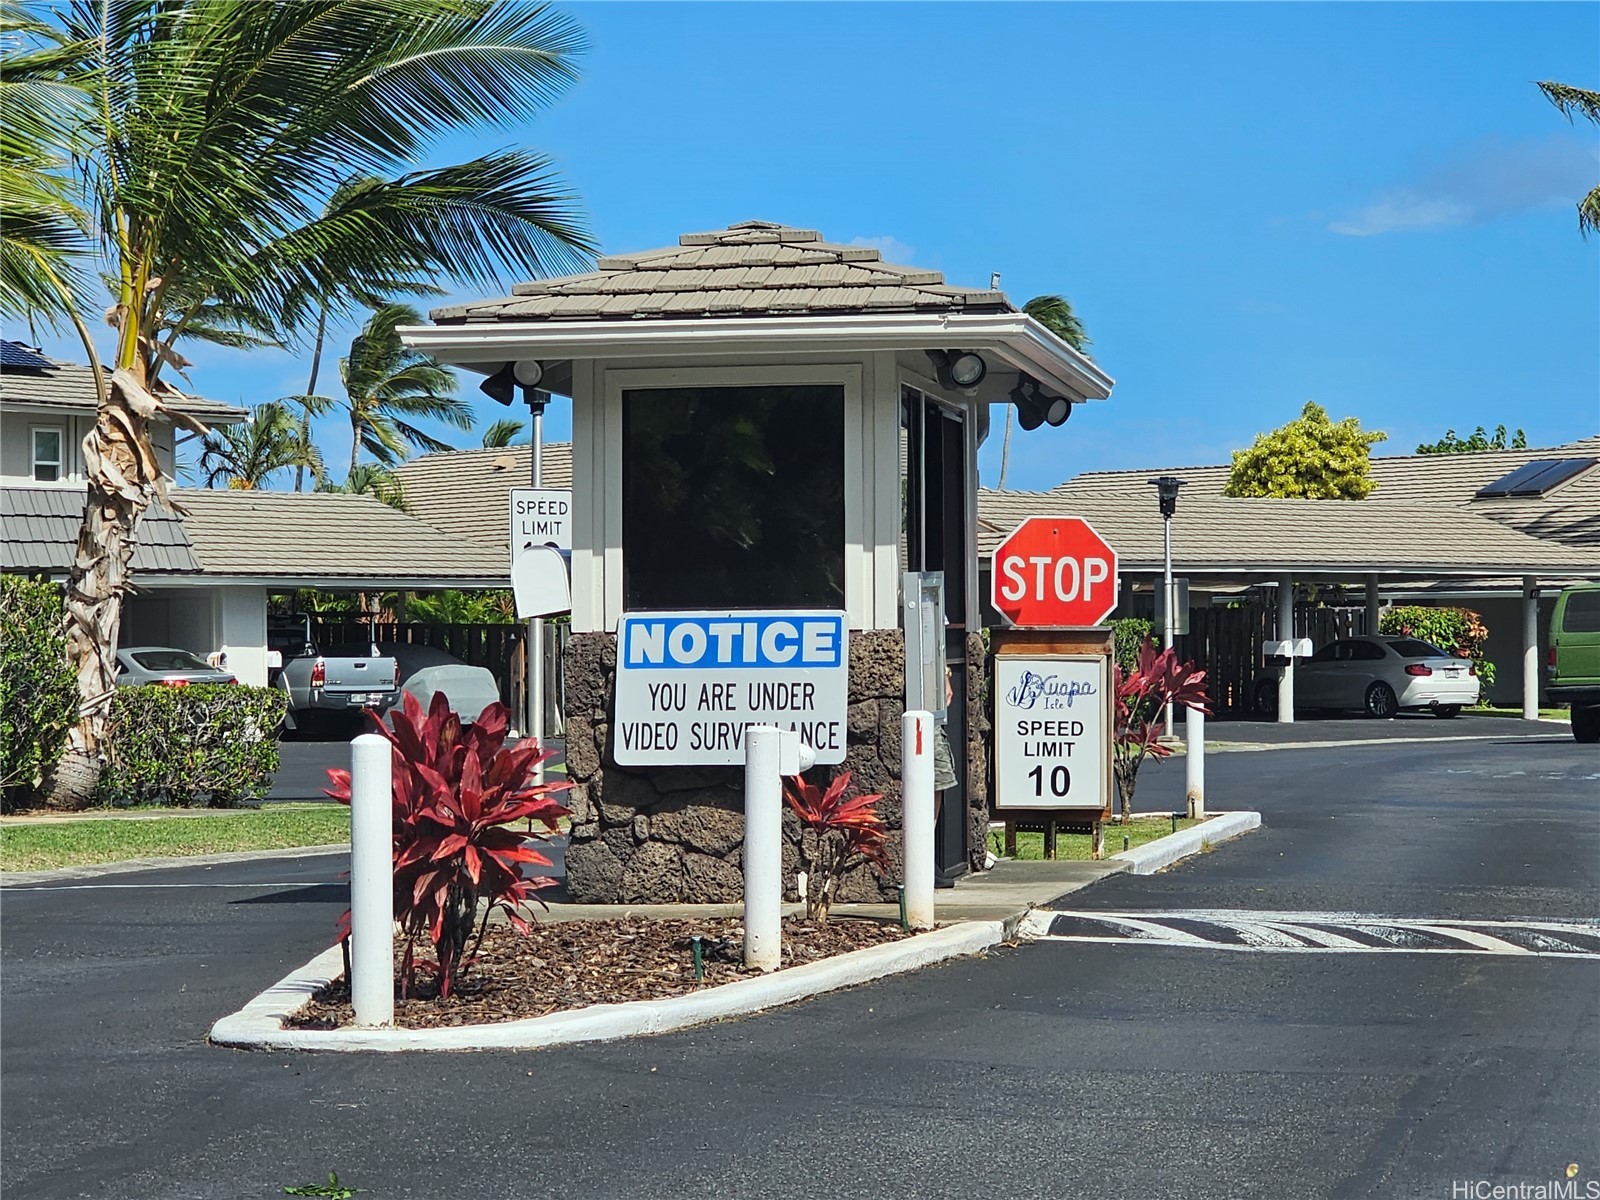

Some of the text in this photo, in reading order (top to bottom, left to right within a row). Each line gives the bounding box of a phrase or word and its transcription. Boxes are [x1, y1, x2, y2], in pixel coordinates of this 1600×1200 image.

[516, 500, 568, 515] SPEED
[522, 520, 563, 535] LIMIT
[1001, 555, 1109, 602] STOP
[629, 621, 836, 664] NOTICE
[648, 682, 815, 711] YOU ARE UNDER
[622, 721, 840, 750] VIDEO SURVNCE
[1017, 720, 1084, 737] SPEED
[1024, 741, 1076, 758] LIMIT
[1028, 765, 1071, 797] 10
